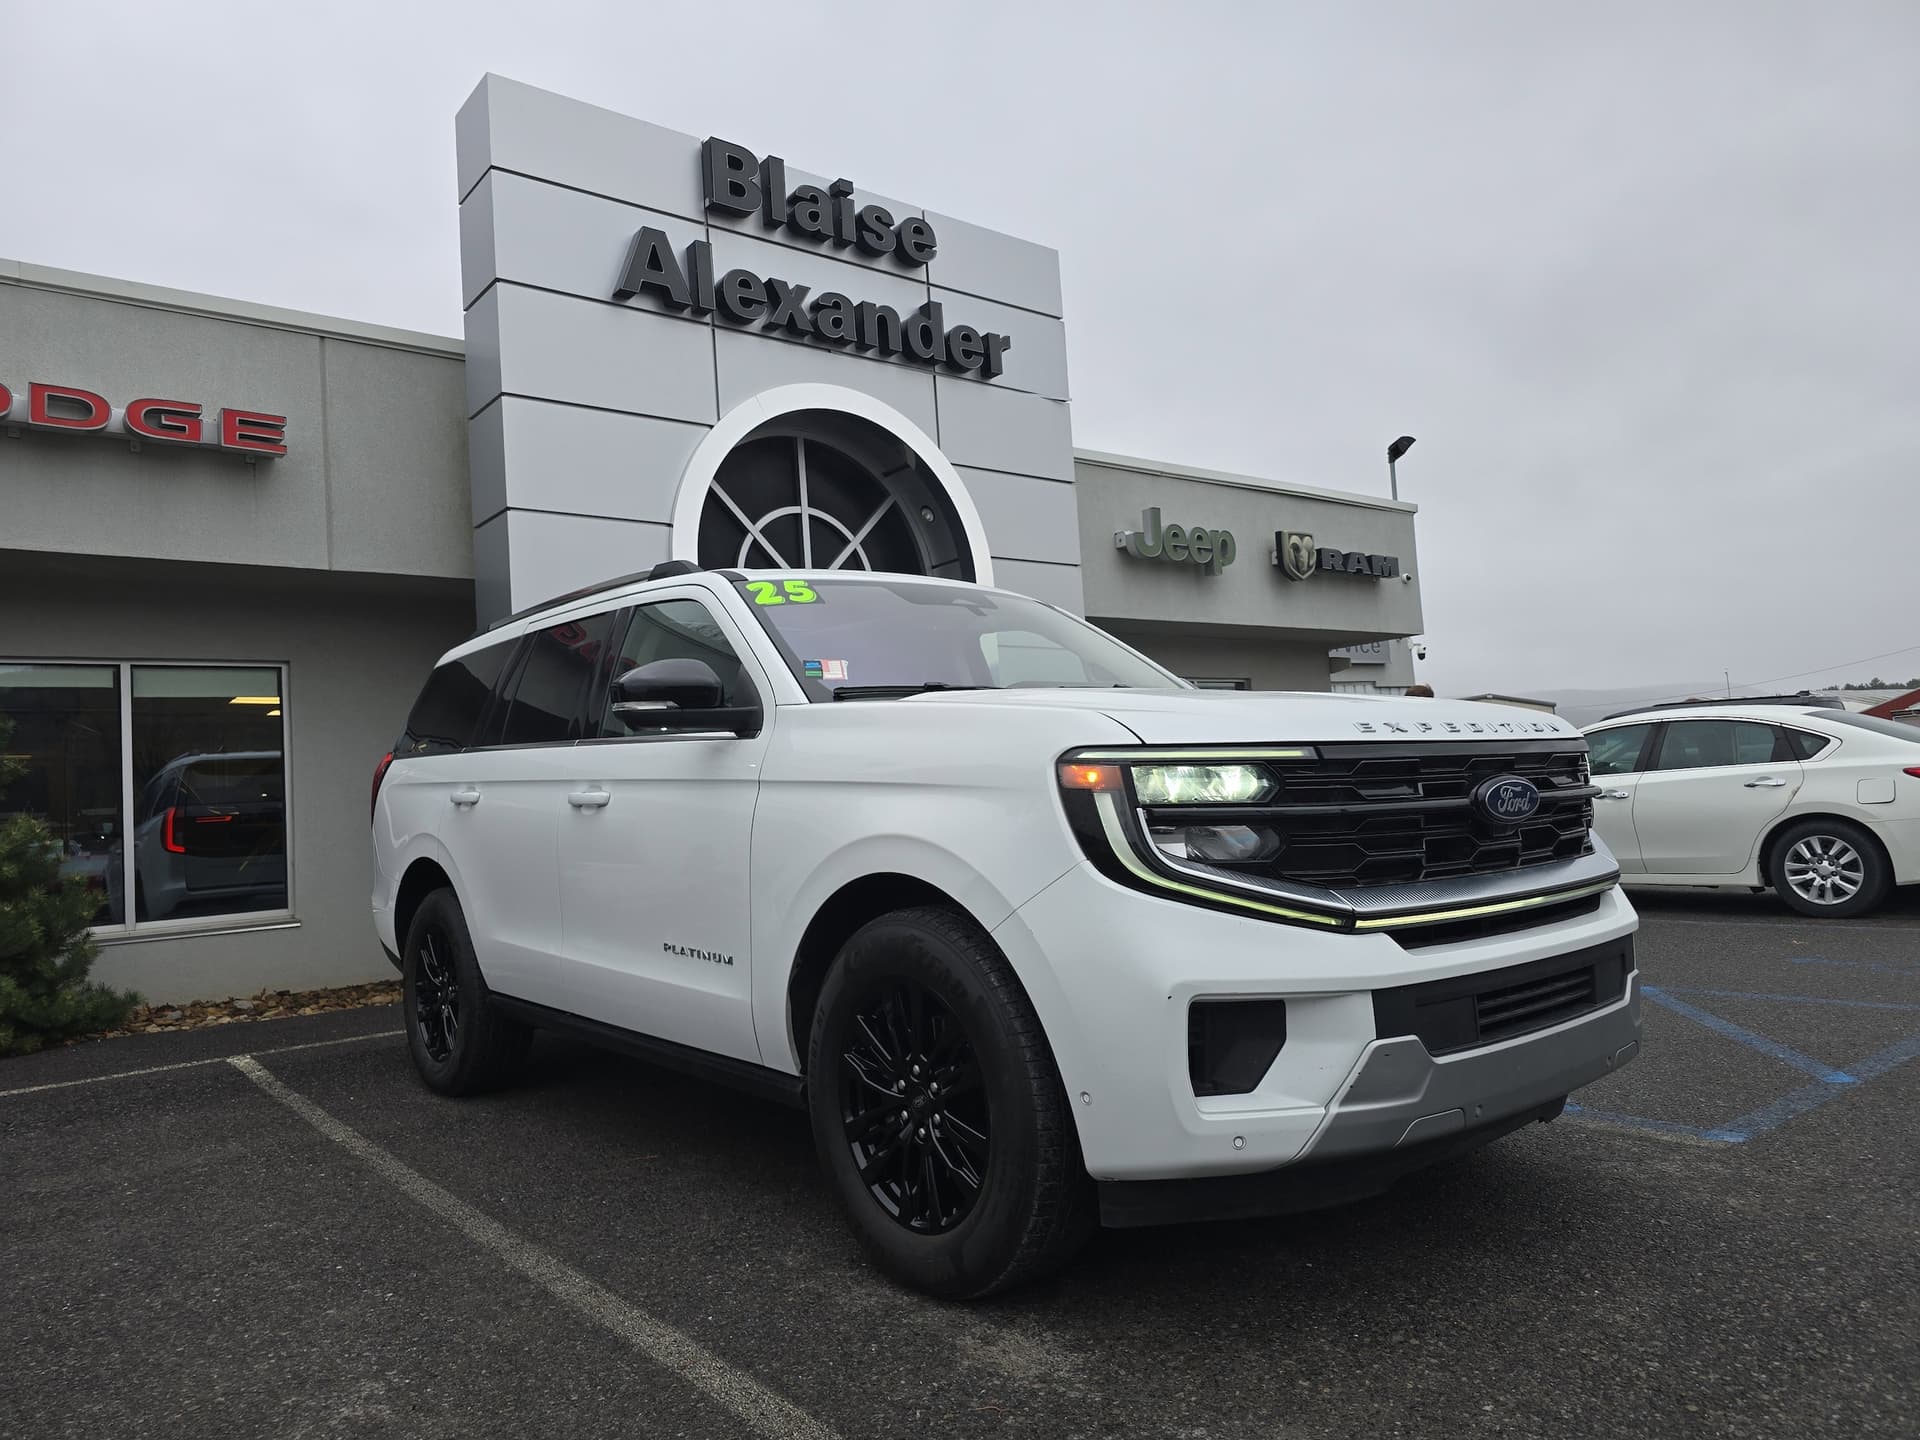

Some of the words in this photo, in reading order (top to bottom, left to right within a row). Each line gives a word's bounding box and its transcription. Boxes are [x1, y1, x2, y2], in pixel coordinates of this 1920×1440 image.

[703, 136, 937, 266] Blaise
[612, 225, 1011, 378] Alexander
[0, 382, 287, 457] DGE
[1127, 507, 1236, 576] Jeep
[1317, 548, 1399, 578] RAM
[745, 580, 816, 604] 25
[1353, 721, 1560, 733] EXPEDITION
[1498, 786, 1530, 812] Ford
[663, 942, 733, 965] PLATINUM
